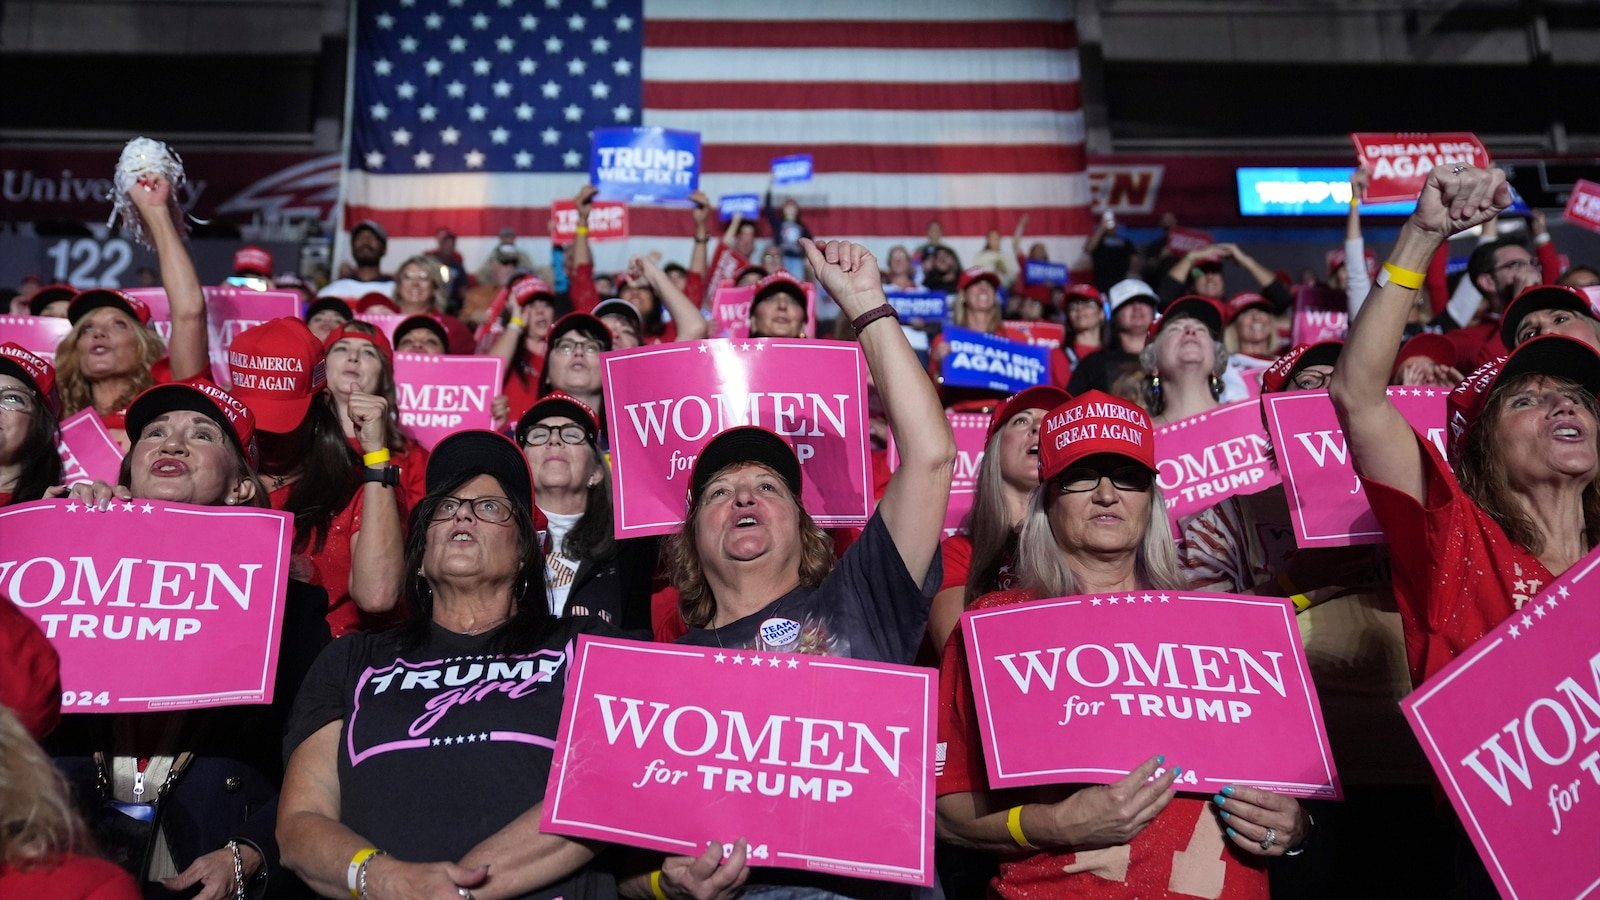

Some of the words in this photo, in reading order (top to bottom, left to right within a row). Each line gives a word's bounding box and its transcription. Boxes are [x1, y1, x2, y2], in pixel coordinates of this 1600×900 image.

[597, 147, 695, 171] TRUMP
[597, 166, 641, 183] WILL
[643, 170, 672, 185] FIX
[674, 173, 693, 186] IT
[46, 239, 133, 287] 122
[249, 355, 304, 373] AMERICA
[950, 340, 1011, 362] DREAM
[1012, 353, 1045, 375] BIG,
[952, 354, 1039, 384] AGAIN!
[258, 376, 298, 391] AGAIN
[1047, 405, 1083, 434] MAKE
[1085, 402, 1148, 430] AMERICA
[1055, 424, 1097, 450] GREAT
[1101, 424, 1142, 447] AGAIN
[667, 450, 697, 480] for
[1180, 467, 1265, 504] TRUMP
[40, 614, 202, 641] TRUMP
[762, 621, 792, 634] TEAM
[763, 623, 799, 641] TRUMP
[371, 652, 566, 696] TRUMP
[994, 642, 1288, 698] WOMEN
[61, 690, 110, 707] 024
[408, 670, 550, 738] girl
[1057, 695, 1105, 726] for
[1110, 693, 1252, 724] TRUMP
[593, 693, 910, 778] WOMEN
[633, 759, 688, 789] for
[697, 764, 853, 803] TRUMP
[1547, 779, 1581, 836] for
